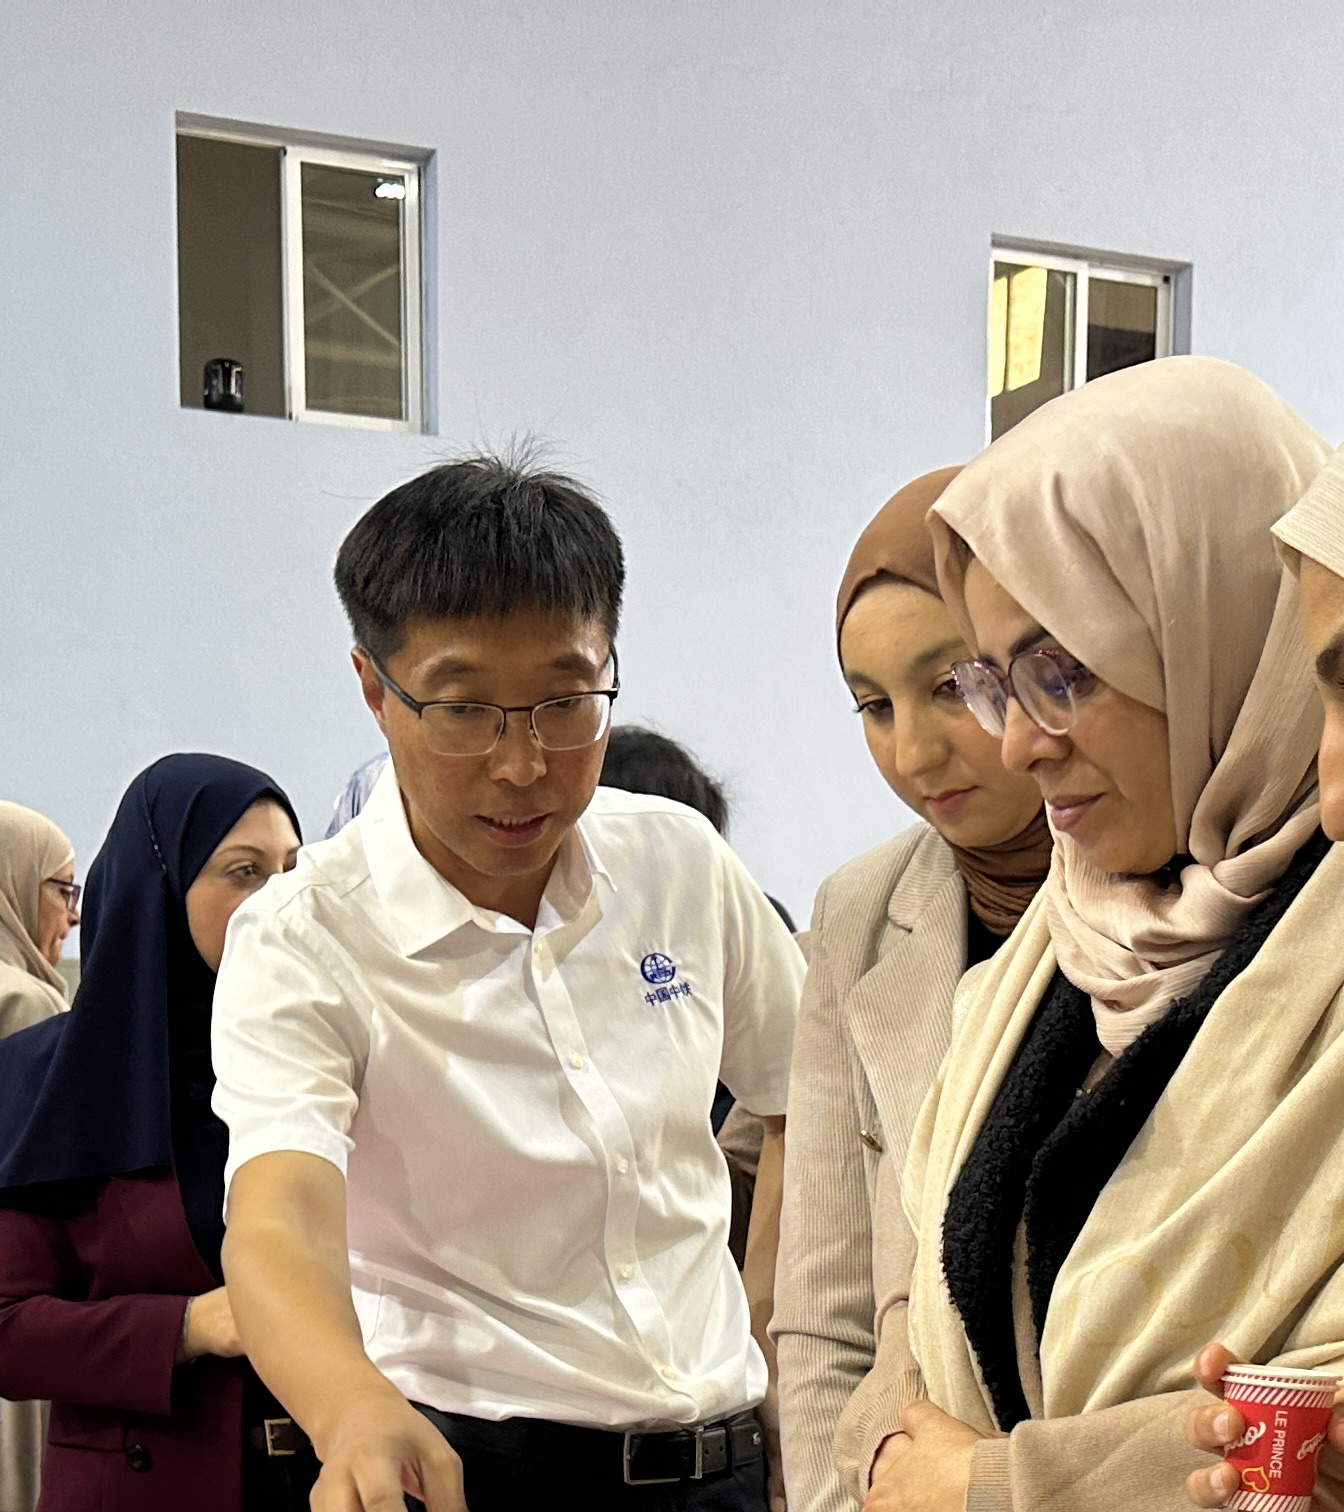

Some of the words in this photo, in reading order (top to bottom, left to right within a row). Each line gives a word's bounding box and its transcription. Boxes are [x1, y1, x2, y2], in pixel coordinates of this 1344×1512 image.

[644, 982, 693, 1007] 中国中铁
[1274, 1410, 1289, 1427] LE
[1269, 1429, 1287, 1479] PRINCE
